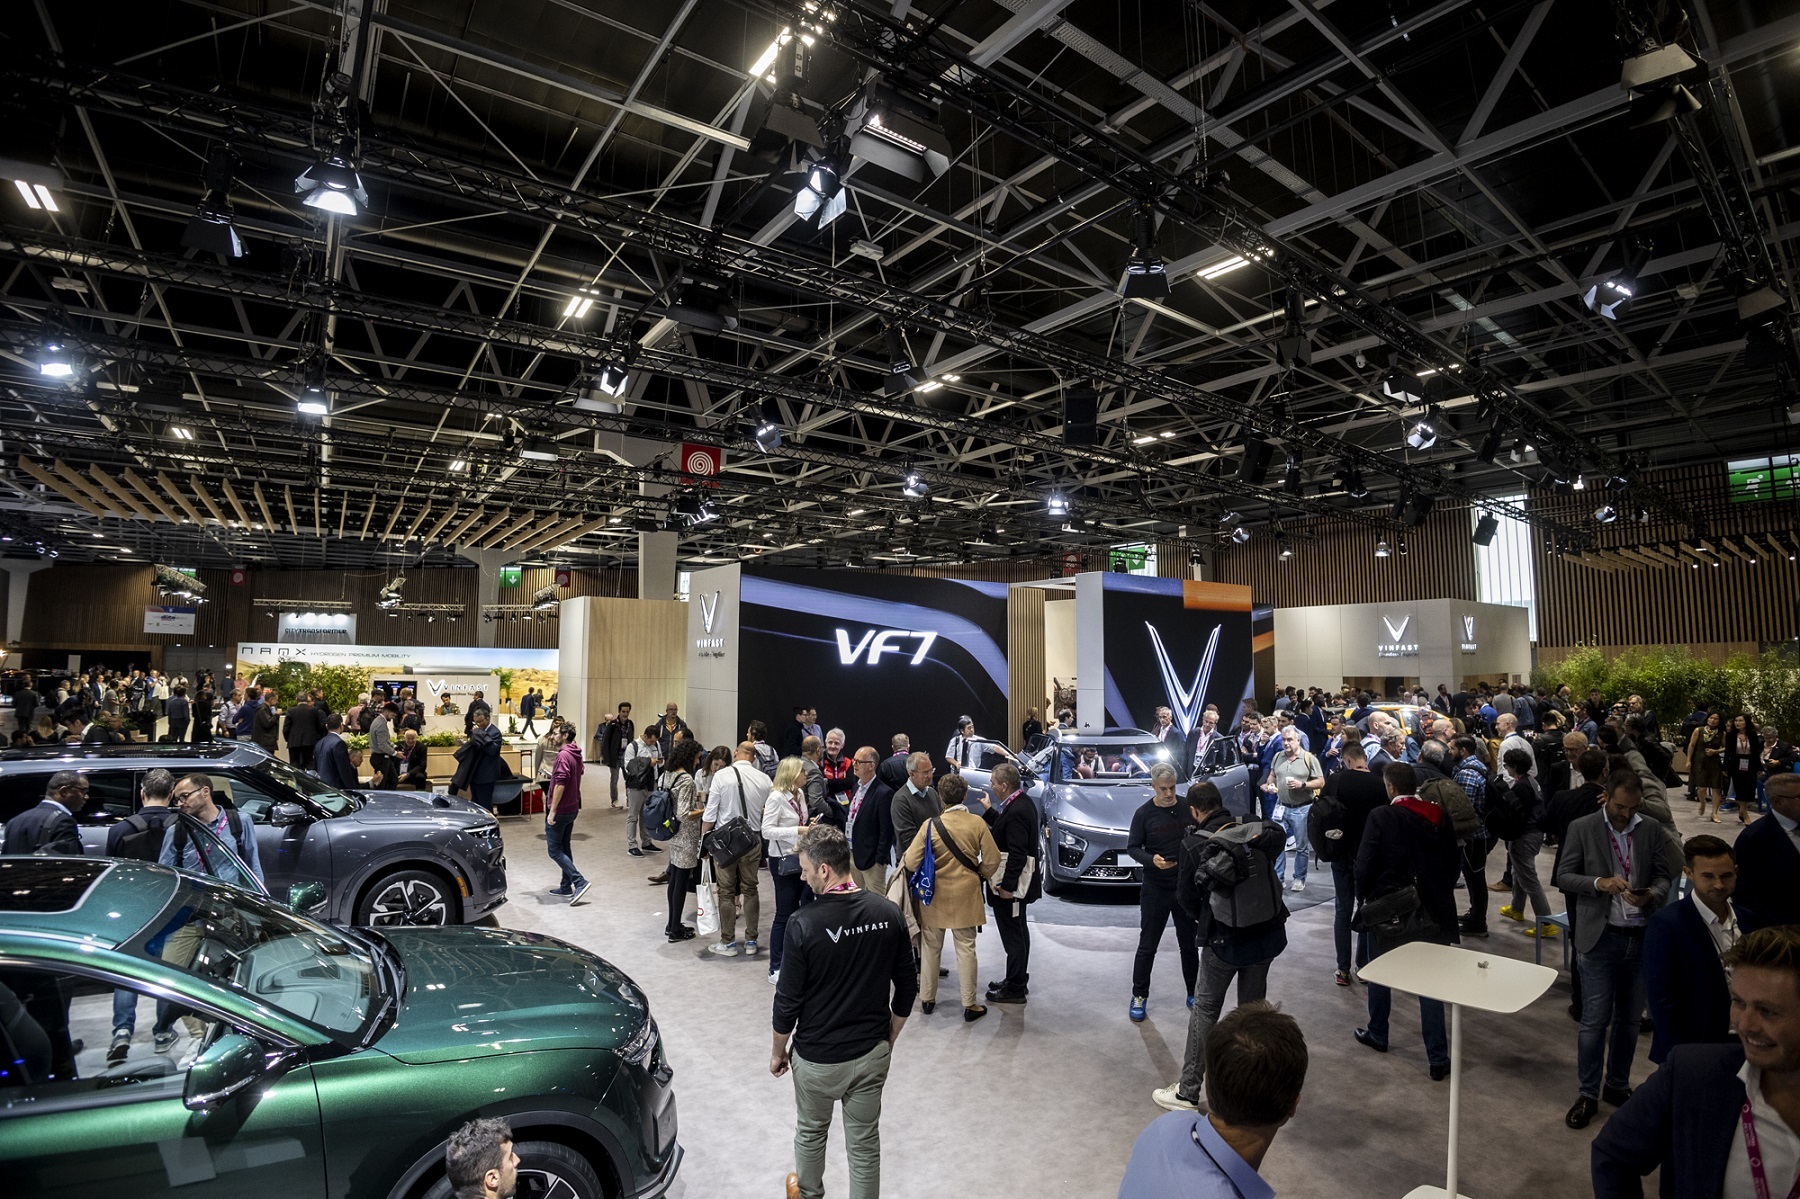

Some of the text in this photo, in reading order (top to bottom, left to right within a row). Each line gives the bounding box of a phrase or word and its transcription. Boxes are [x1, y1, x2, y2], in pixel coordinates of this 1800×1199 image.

[696, 638, 724, 648] VINFAST
[835, 628, 938, 664] VF7
[443, 683, 488, 691] VINFAST
[843, 921, 889, 936] VINFAST
